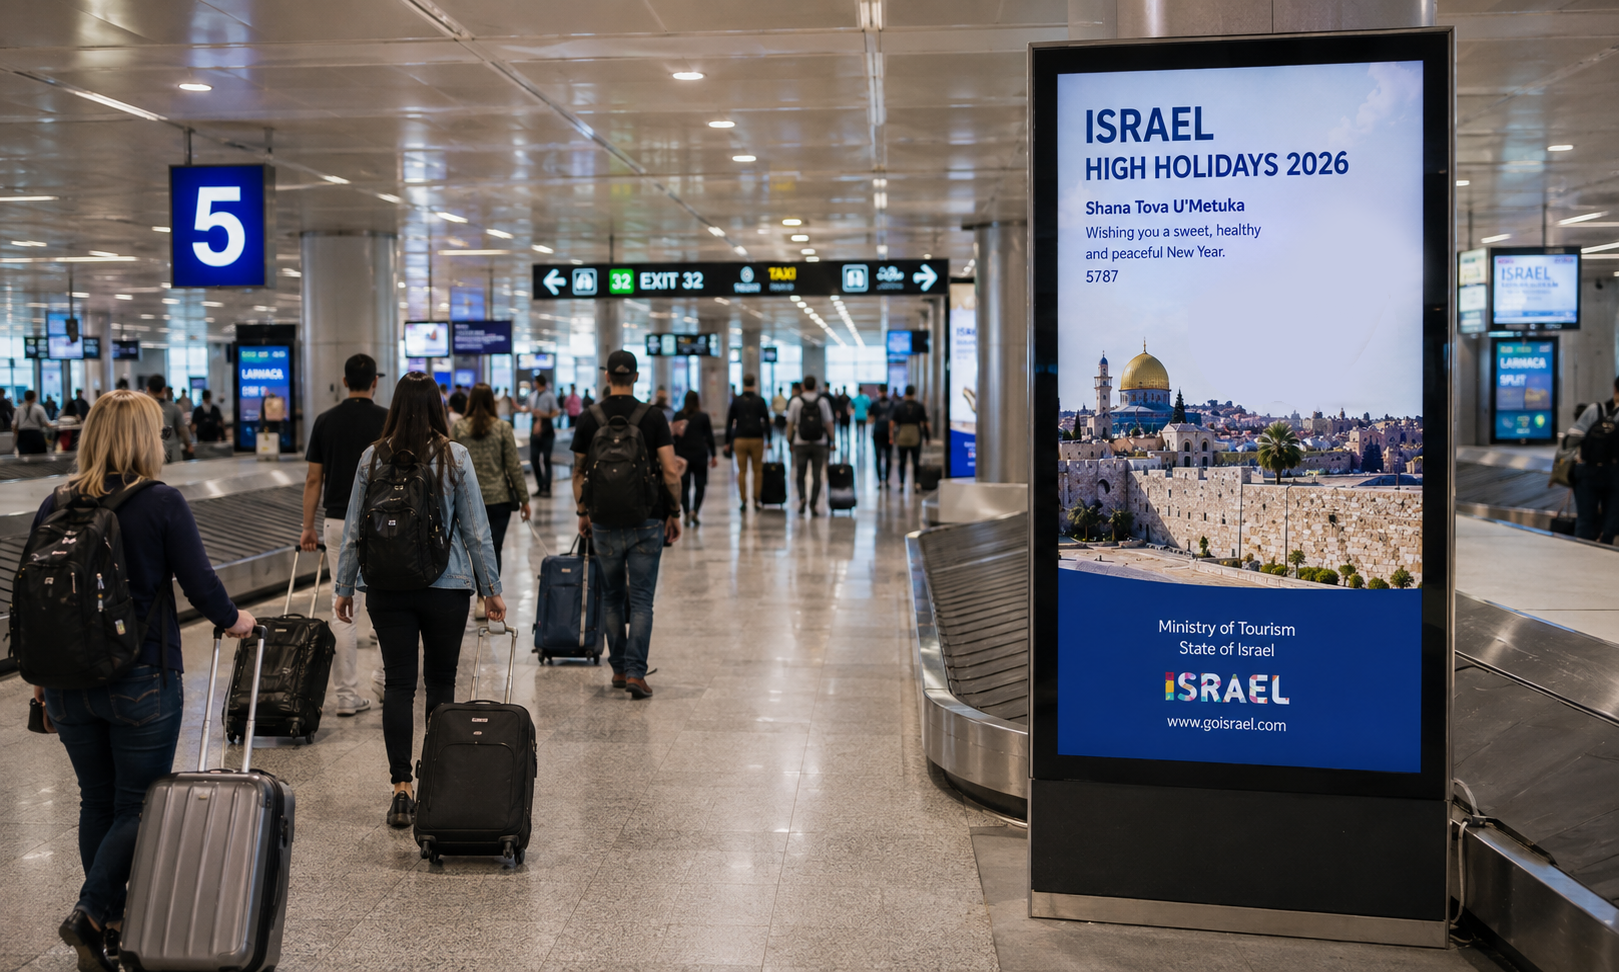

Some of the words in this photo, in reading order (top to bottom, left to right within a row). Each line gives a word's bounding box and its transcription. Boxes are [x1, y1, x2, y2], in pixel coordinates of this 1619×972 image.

[1085, 106, 1215, 144] ISRAEL
[1085, 156, 1147, 181] HIGH
[1154, 152, 1279, 179] HOLIDAYS
[1286, 150, 1350, 176] 2026
[1085, 201, 1131, 216] Shana
[1134, 199, 1169, 214] Tova
[1173, 198, 1245, 214] U'Metuka
[192, 186, 246, 268] 5
[1085, 226, 1135, 241] Wishing
[1137, 228, 1160, 241] you
[1162, 228, 1170, 238] a
[1173, 225, 1213, 239] sweet,
[1216, 223, 1262, 239] healthy
[1085, 247, 1108, 260] and
[1111, 245, 1163, 262] peaceful
[1166, 246, 1194, 259] New
[1196, 245, 1226, 259] Year.
[612, 273, 631, 290] 32
[640, 272, 679, 290] EXIT
[682, 271, 704, 290] 32
[768, 267, 797, 281] TAXI
[1085, 269, 1119, 284] 5787
[1501, 266, 1551, 281] ISRAEL
[1158, 619, 1217, 637] Ministry
[1219, 621, 1235, 635] of
[1237, 621, 1296, 637] Tourism
[1179, 641, 1216, 655] State
[1219, 642, 1235, 656] of
[1238, 642, 1275, 657] Israel
[1165, 671, 1290, 705] ISRAEL
[1167, 716, 1287, 732] www.goisrael.com
